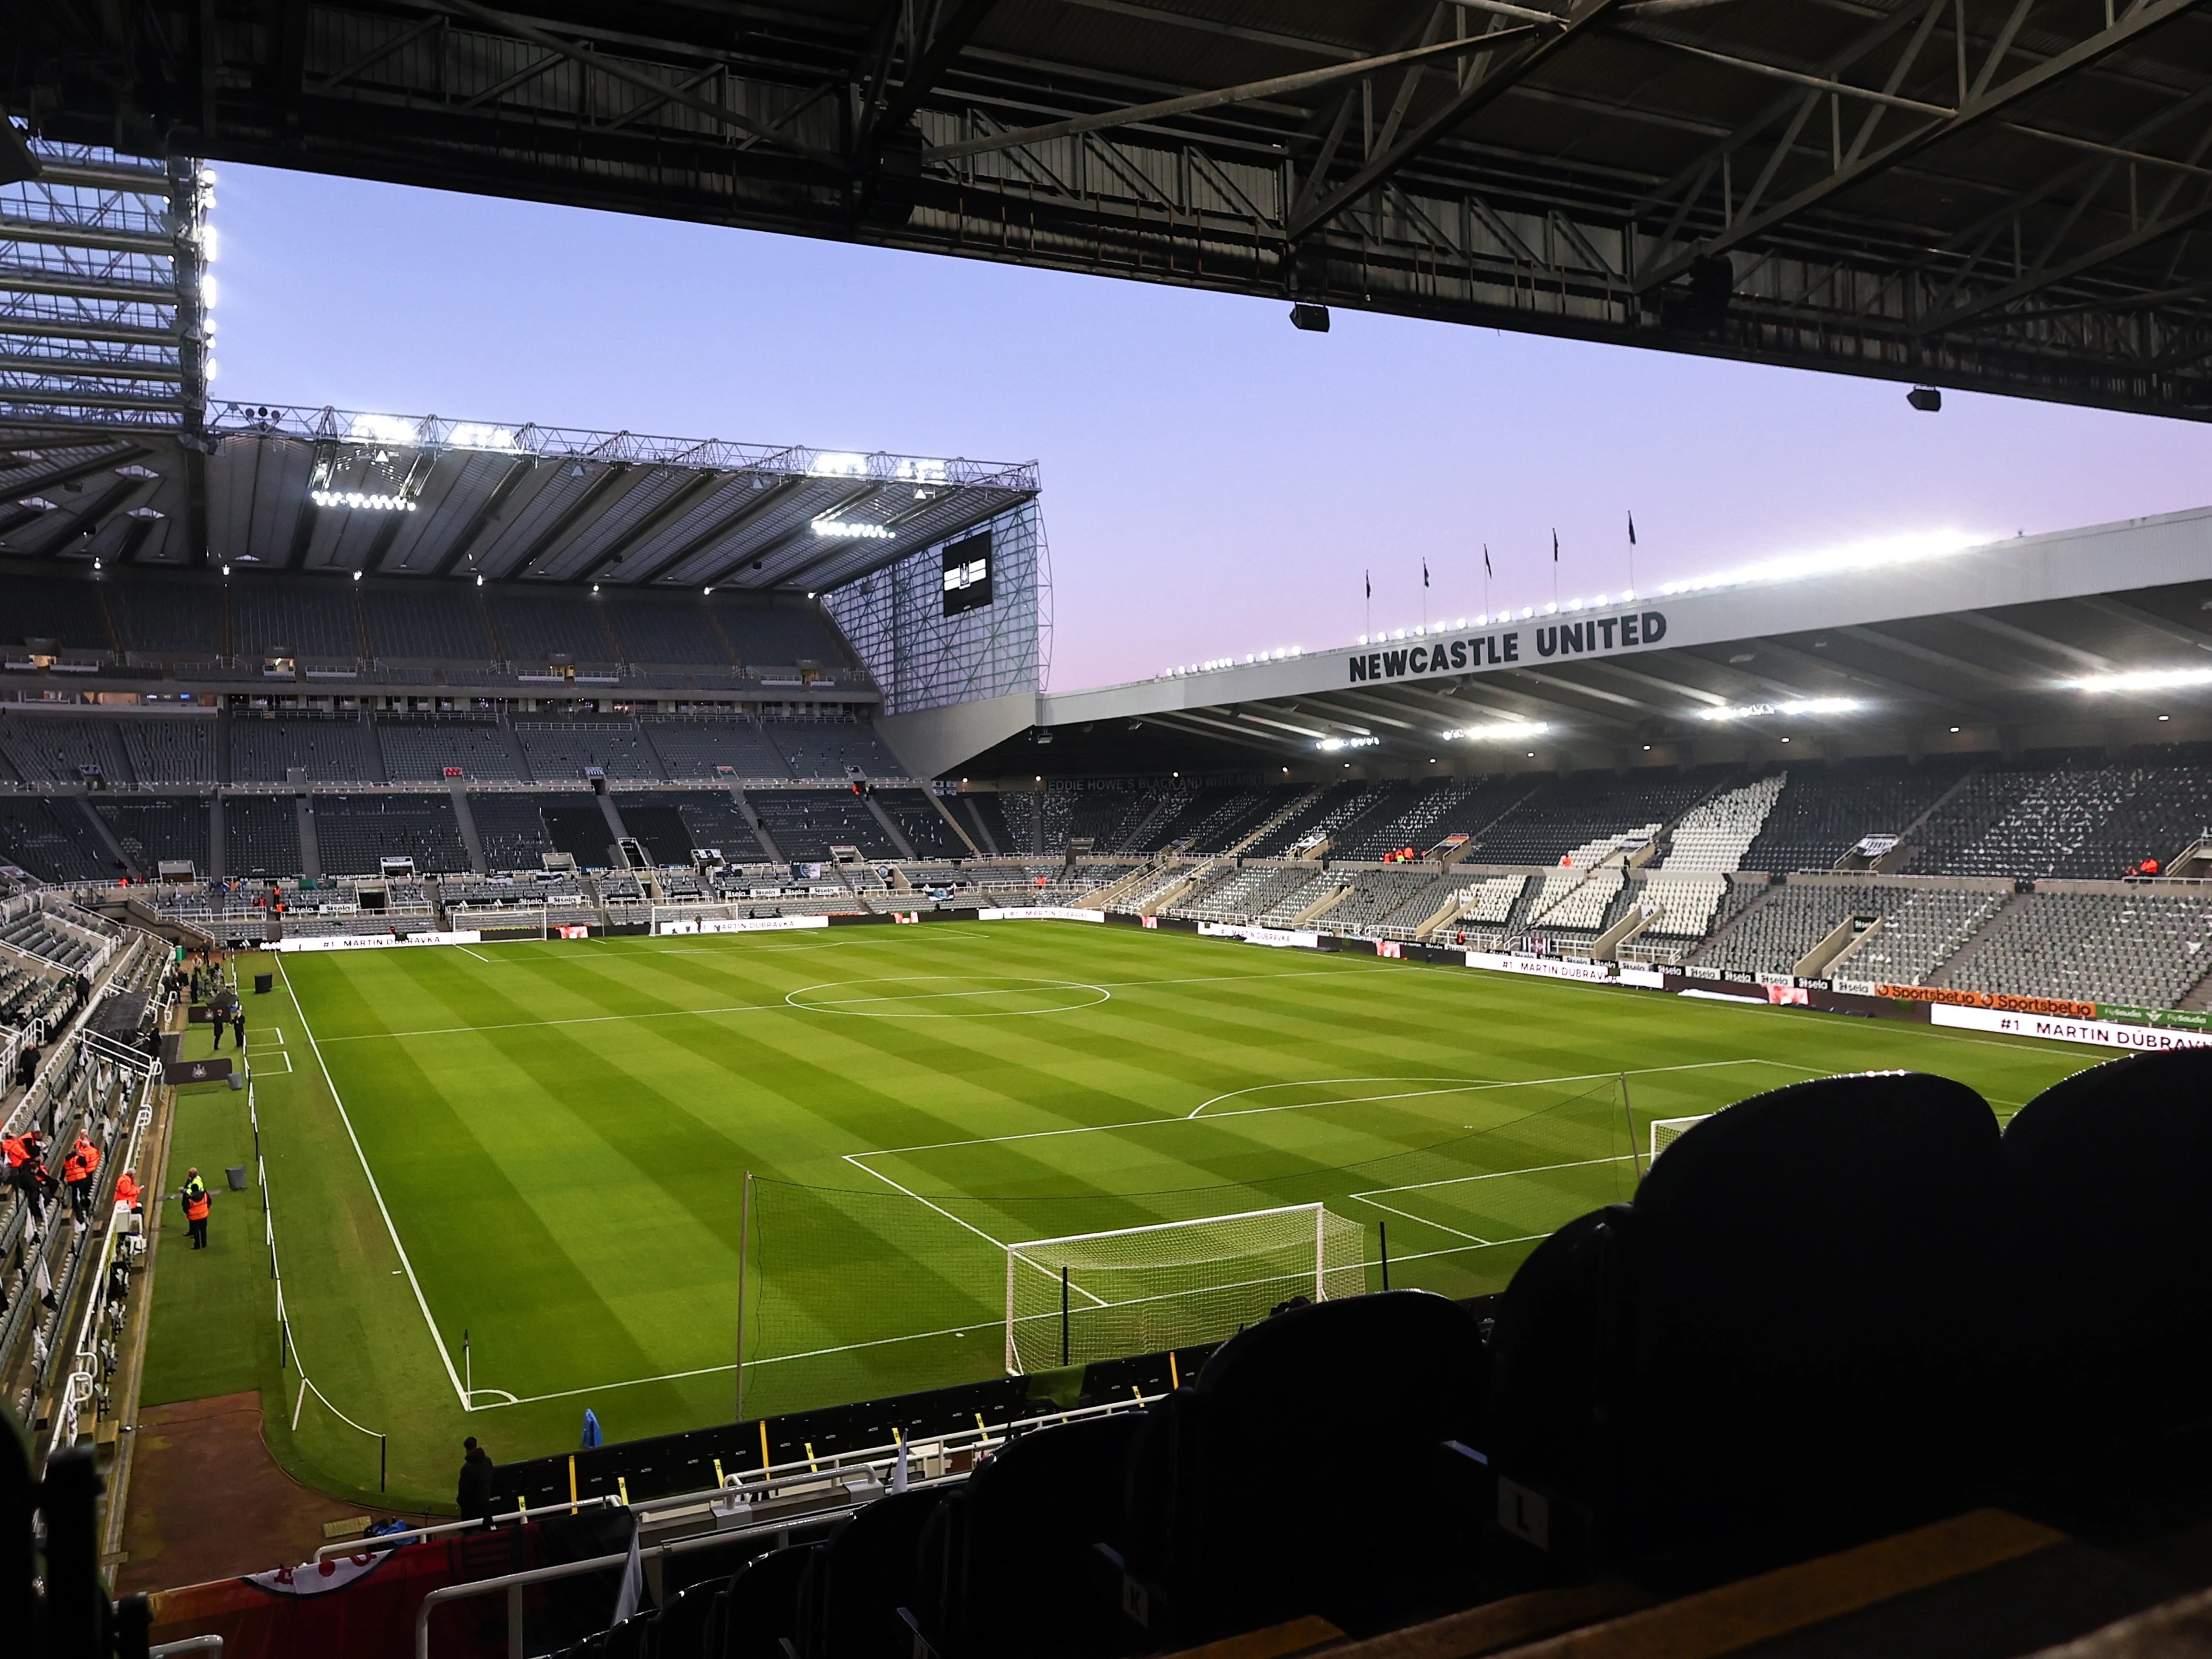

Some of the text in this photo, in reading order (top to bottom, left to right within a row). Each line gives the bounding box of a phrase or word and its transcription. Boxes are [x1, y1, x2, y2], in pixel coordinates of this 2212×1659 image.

[1350, 610, 1667, 683] NEWCASTLE UNITED
[1048, 780, 1084, 791] EDDIE
[1139, 778, 1175, 789] BLACK
[1178, 777, 1203, 790] AND
[1205, 775, 1235, 787] WHITE
[1521, 962, 1558, 975] MARTIN
[1892, 985, 1975, 1006] Sportsbet.io
[1998, 995, 2091, 1017] Sportsbet.io
[2000, 1018, 2212, 1051] #1 MARTIN DÚBRA
[1516, 1492, 1532, 1533] L
[1130, 1585, 1142, 1618] K
